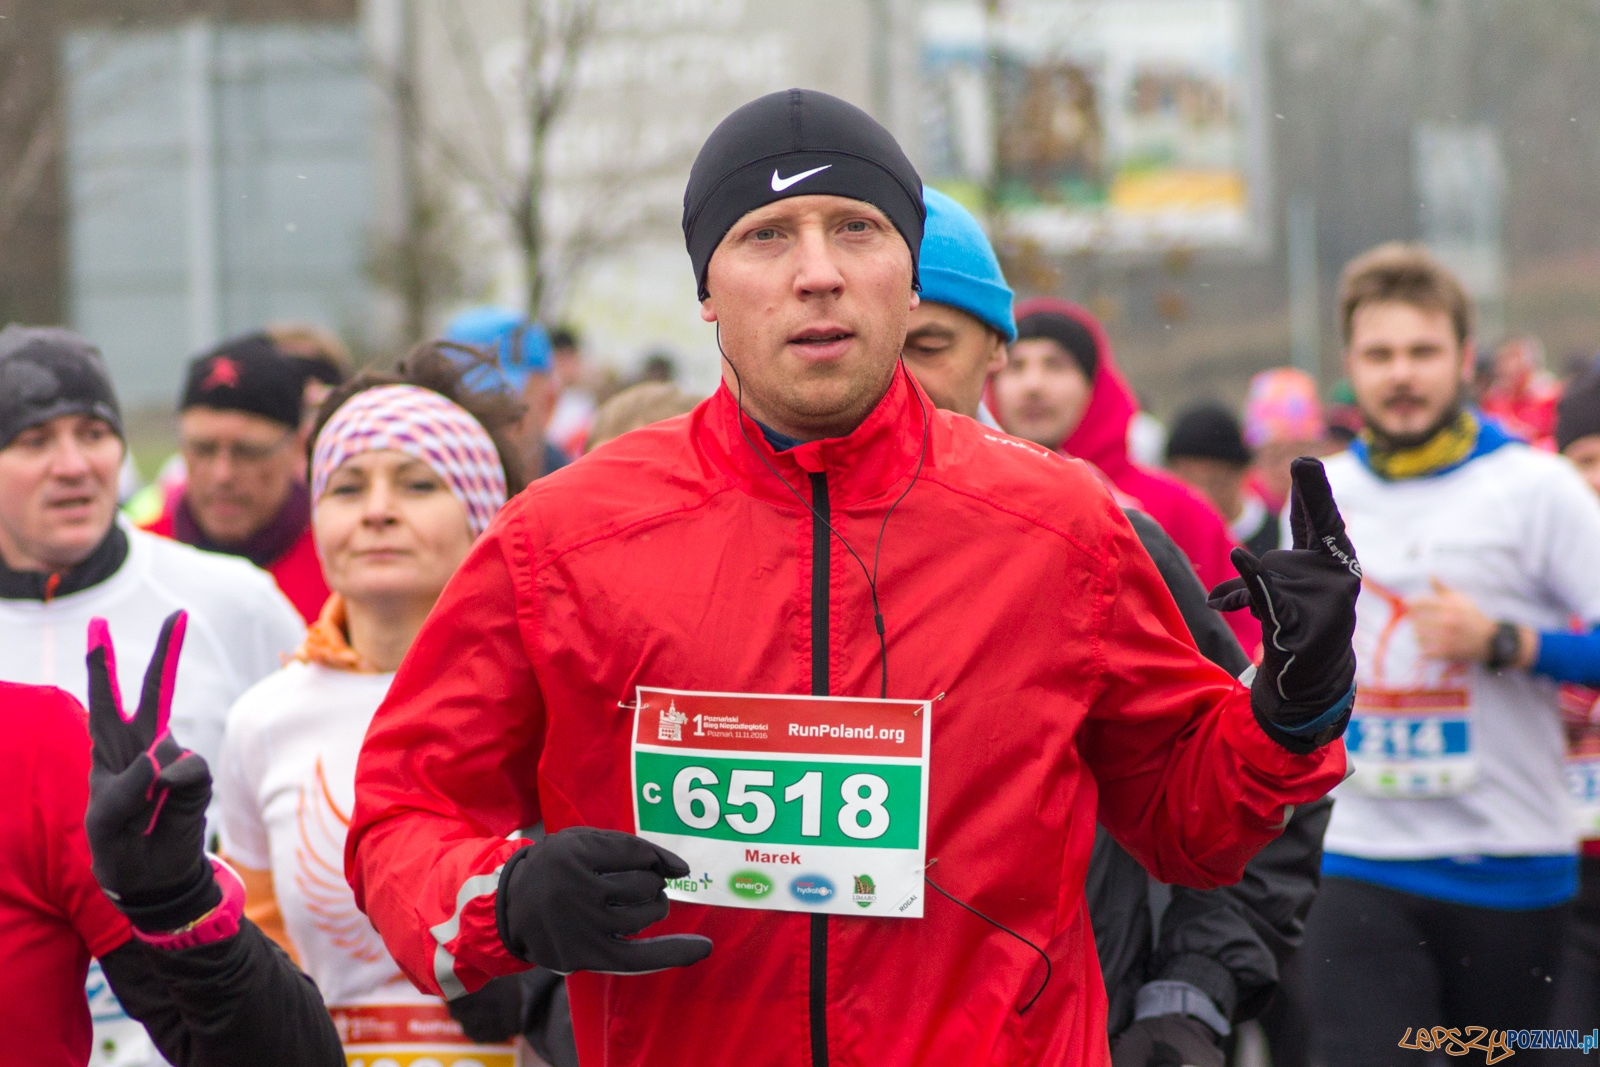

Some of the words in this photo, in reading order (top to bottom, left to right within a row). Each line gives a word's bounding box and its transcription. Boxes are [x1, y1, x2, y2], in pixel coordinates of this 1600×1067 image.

[693, 713, 705, 737] 1
[703, 722, 719, 730] Bieg
[735, 731, 768, 739] 11.11.2016
[788, 723, 905, 743] RunPoland.org
[672, 765, 891, 840] 6518
[745, 849, 801, 865] Marek
[665, 878, 698, 893] XMED
[735, 882, 769, 894] energy
